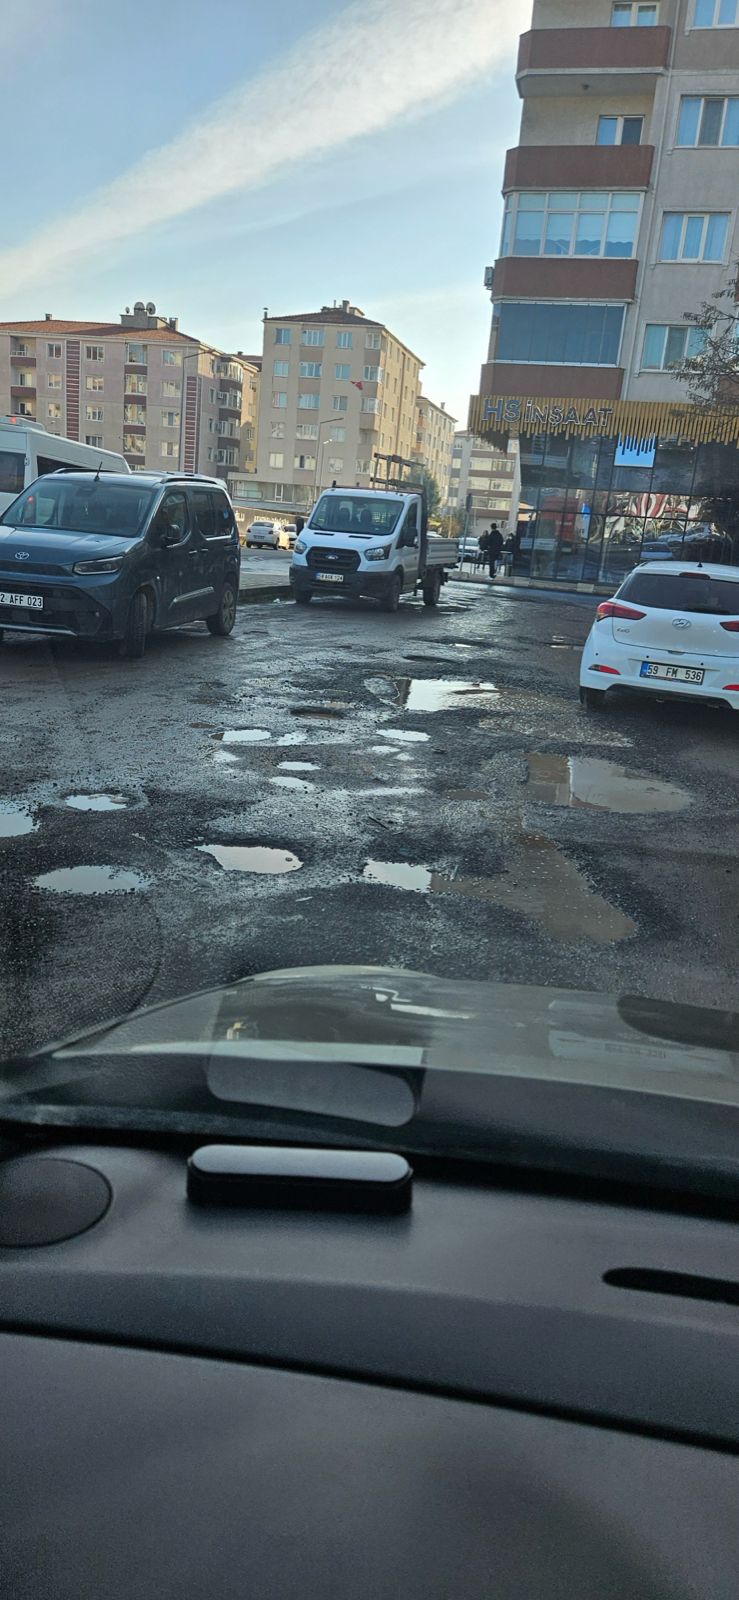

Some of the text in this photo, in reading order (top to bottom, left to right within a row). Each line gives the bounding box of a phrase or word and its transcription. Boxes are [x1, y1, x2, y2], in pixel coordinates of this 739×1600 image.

[482, 398, 521, 422] HS
[9, 594, 24, 605] AFF
[27, 596, 42, 607] 023
[646, 665, 702, 681] 59 FM 536
